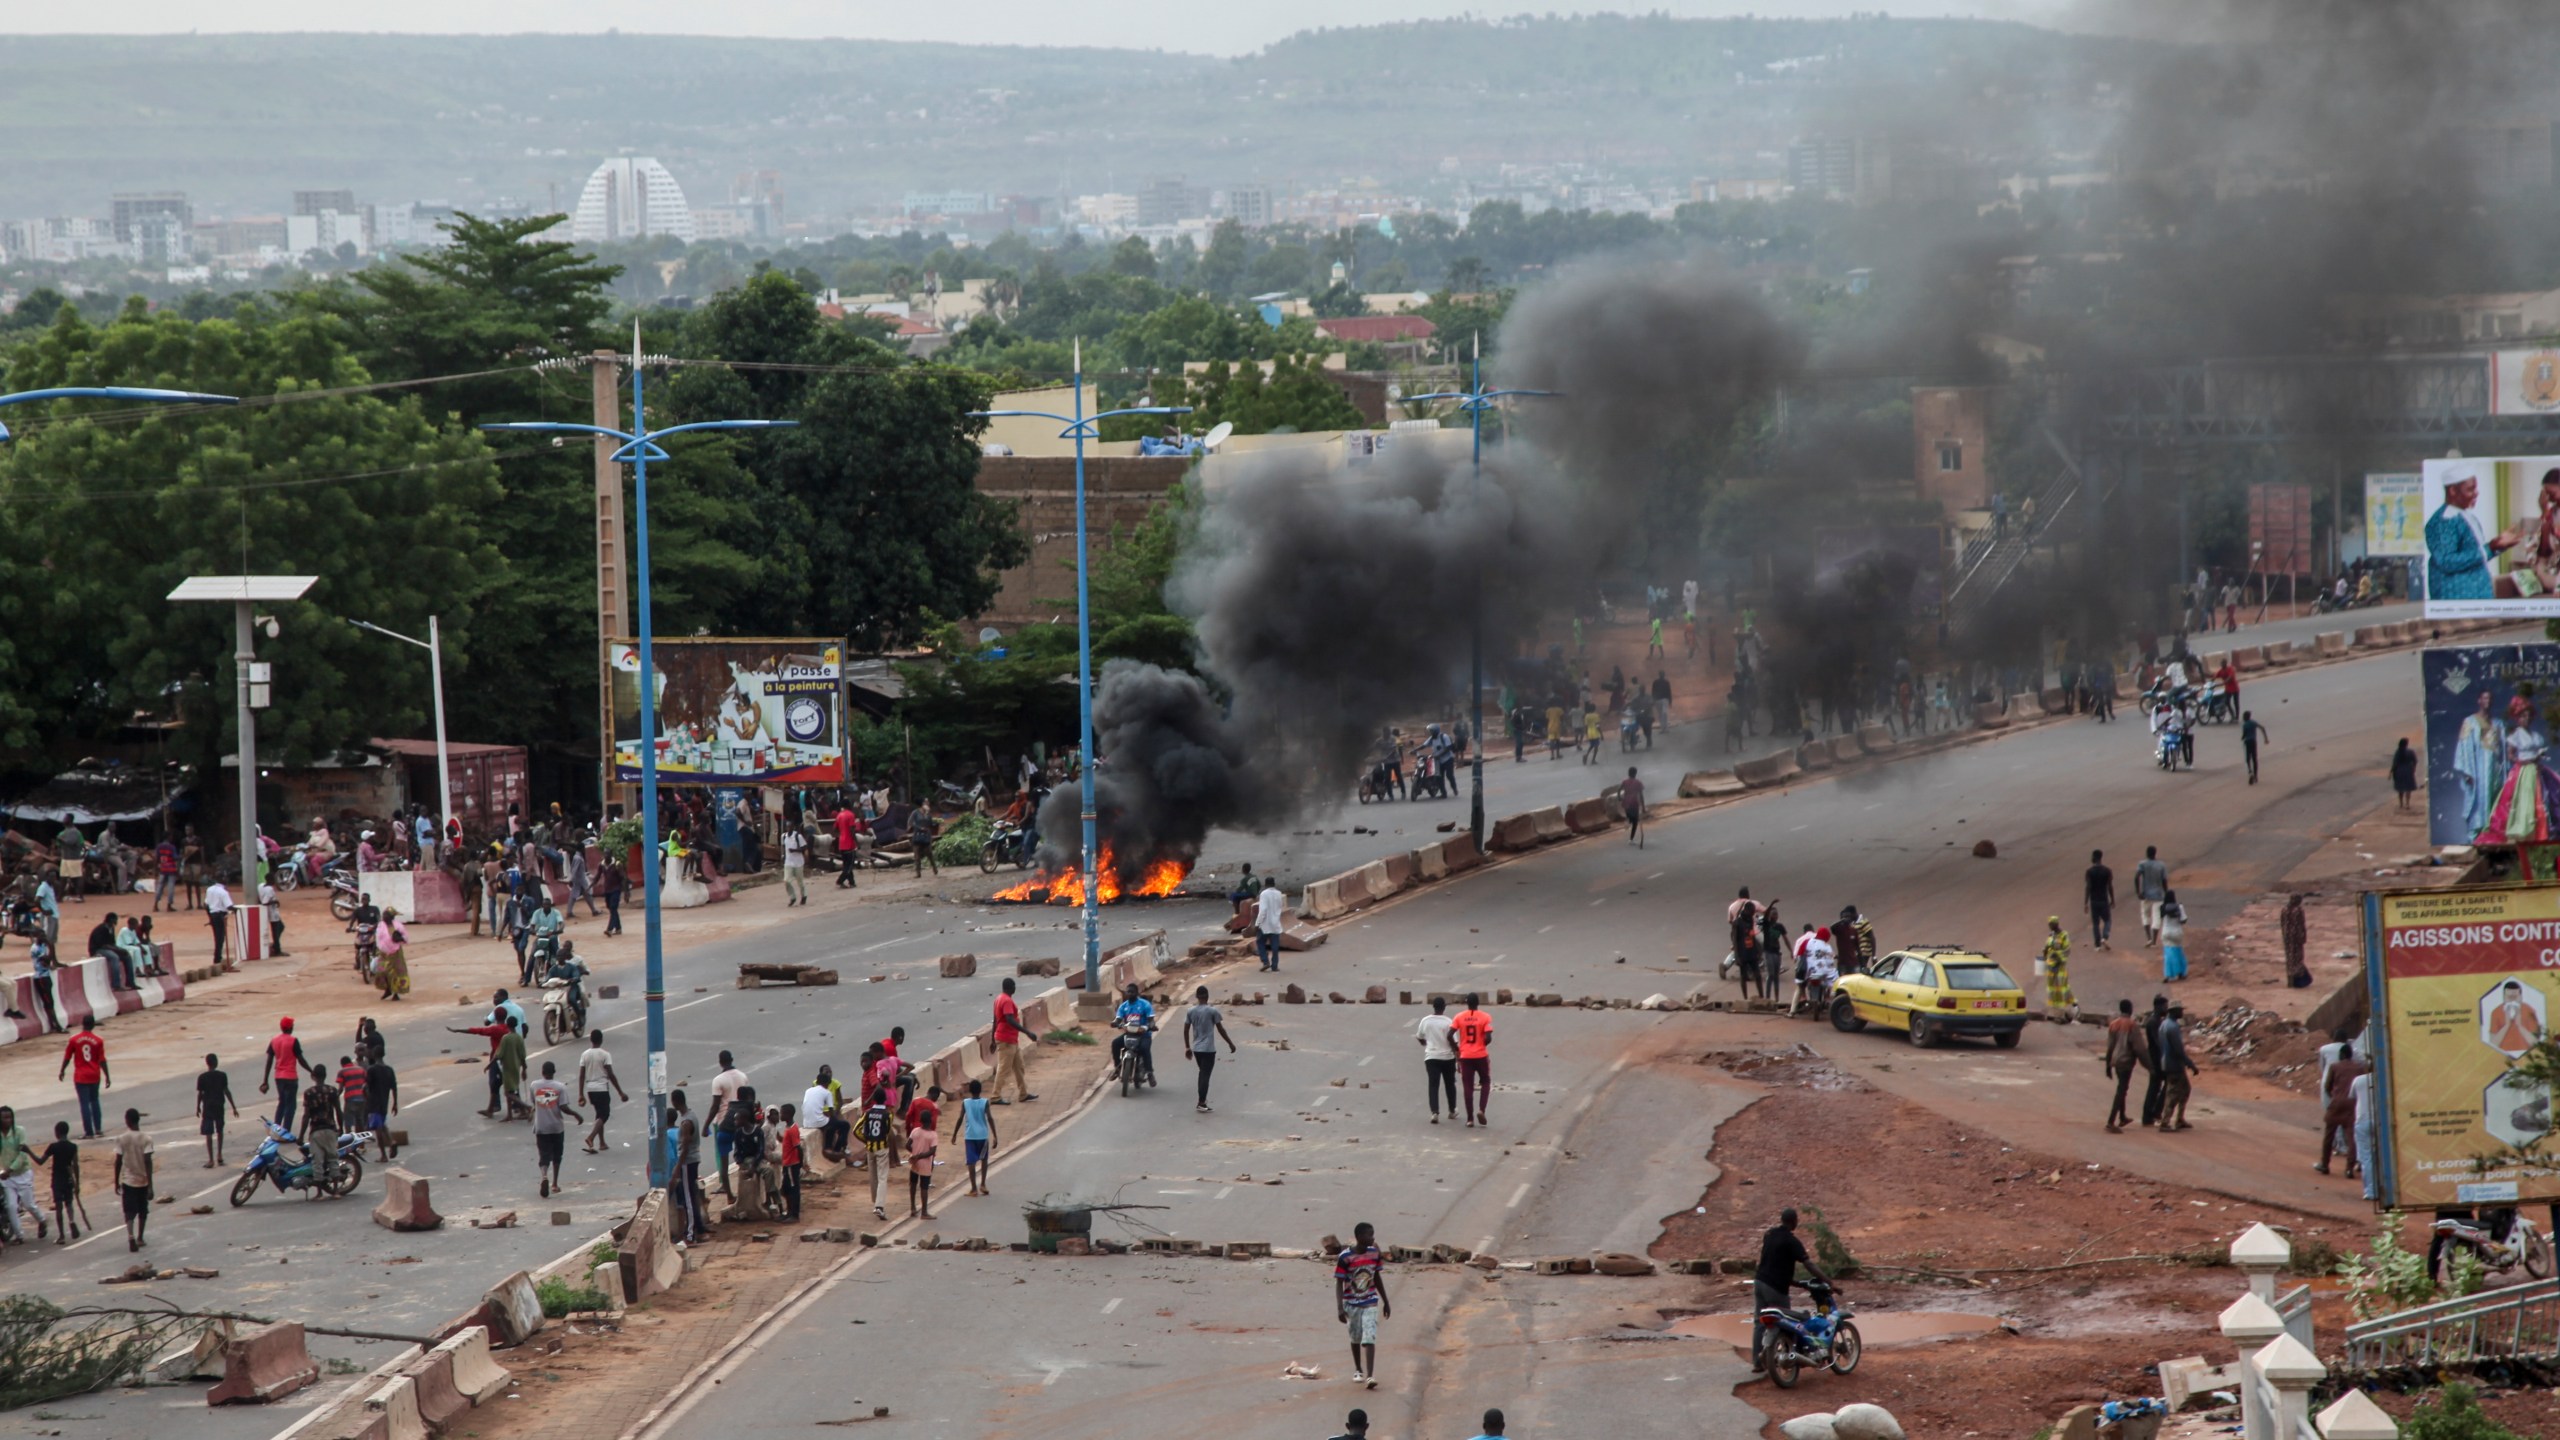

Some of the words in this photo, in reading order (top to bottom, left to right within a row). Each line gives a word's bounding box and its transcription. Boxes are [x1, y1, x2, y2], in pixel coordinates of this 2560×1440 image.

[791, 667, 831, 678] passe
[775, 682, 786, 691] la
[789, 681, 835, 692] peinture
[2442, 898, 2453, 906] DE
[2455, 897, 2467, 905] LA
[2498, 894, 2508, 903] ET
[2401, 911, 2418, 919] DES
[2420, 908, 2459, 918] AFFAIRES
[2461, 906, 2504, 916] SOCIALES
[2390, 925, 2495, 949] AGISSONS
[1466, 1025, 1477, 1044] 9
[82, 1044, 92, 1062] 8
[868, 1120, 881, 1137] 18
[2417, 1160, 2434, 1171] Le
[2486, 1169, 2517, 1182] pour
